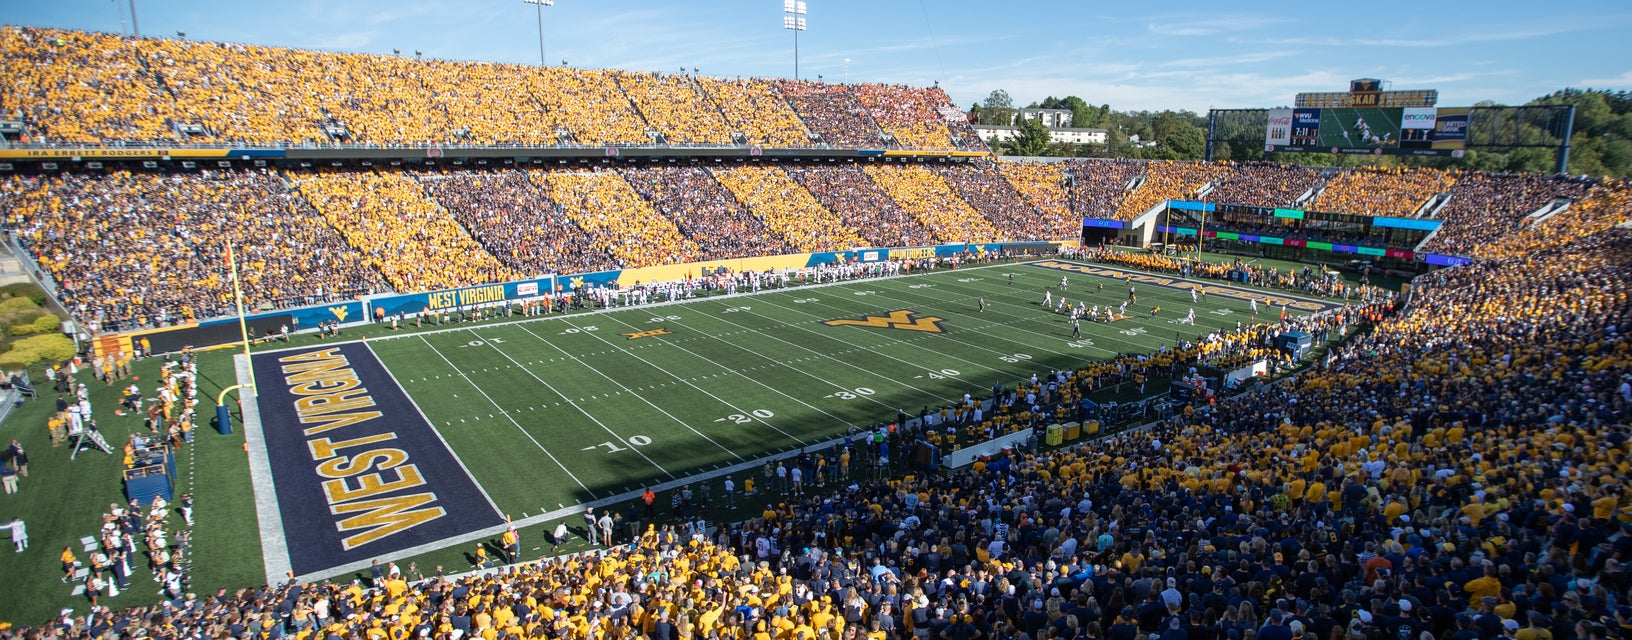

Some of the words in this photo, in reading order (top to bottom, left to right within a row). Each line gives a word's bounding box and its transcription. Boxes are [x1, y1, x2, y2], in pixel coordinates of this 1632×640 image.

[1296, 127, 1309, 136] 7:11
[888, 247, 936, 259] MOUNTAINEERS
[428, 290, 457, 310] WEST
[458, 285, 505, 305] VIRGINIA
[999, 353, 1033, 363] 50
[928, 368, 960, 380] 40
[278, 347, 383, 436] VIRGINIA
[834, 387, 876, 400] 30
[728, 409, 774, 425] 20
[598, 435, 652, 454] 10
[307, 431, 447, 551] WEST
